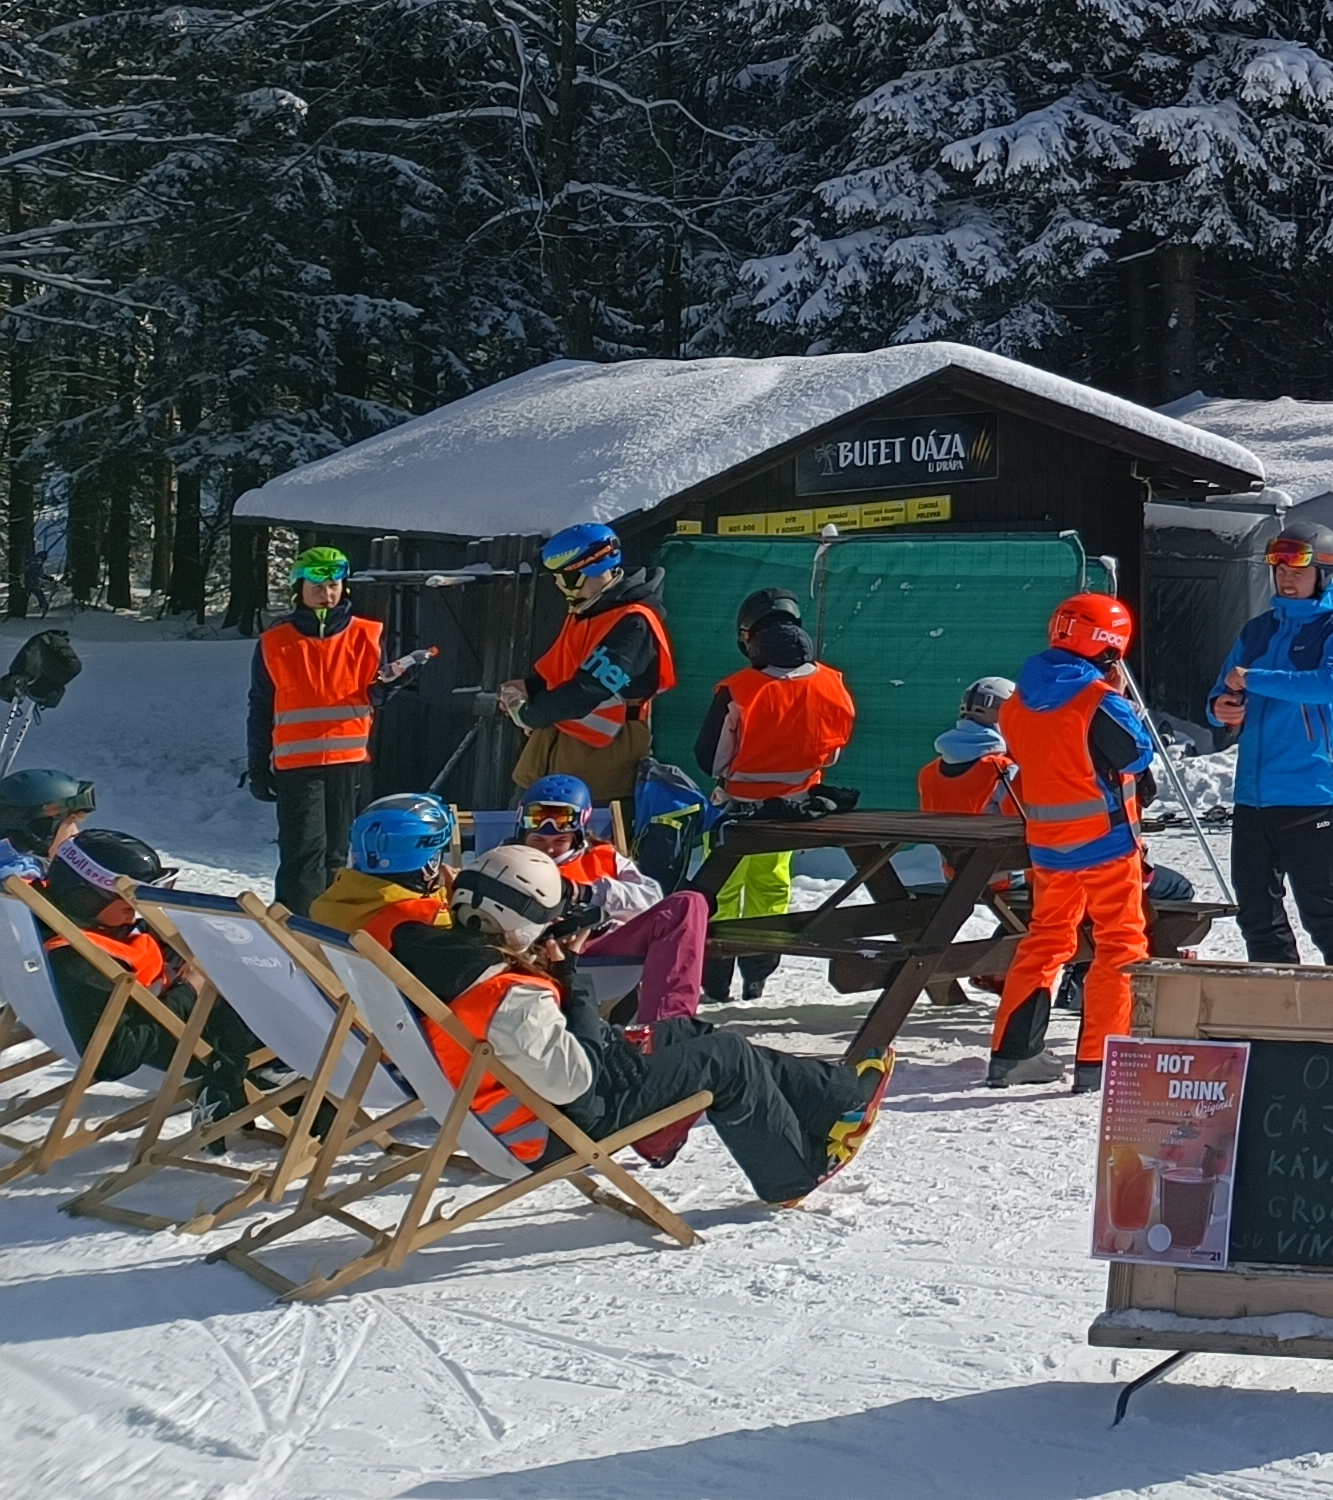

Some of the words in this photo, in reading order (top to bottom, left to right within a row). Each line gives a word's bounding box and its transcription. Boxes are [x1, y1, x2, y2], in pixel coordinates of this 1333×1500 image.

[837, 437, 906, 468] BUFET
[911, 429, 966, 462] OÁZA
[928, 462, 935, 473] U
[936, 459, 964, 473] DRÁPA
[1156, 1053, 1195, 1075] HOT
[1168, 1079, 1228, 1101] DRINK
[1194, 1092, 1236, 1118] Original
